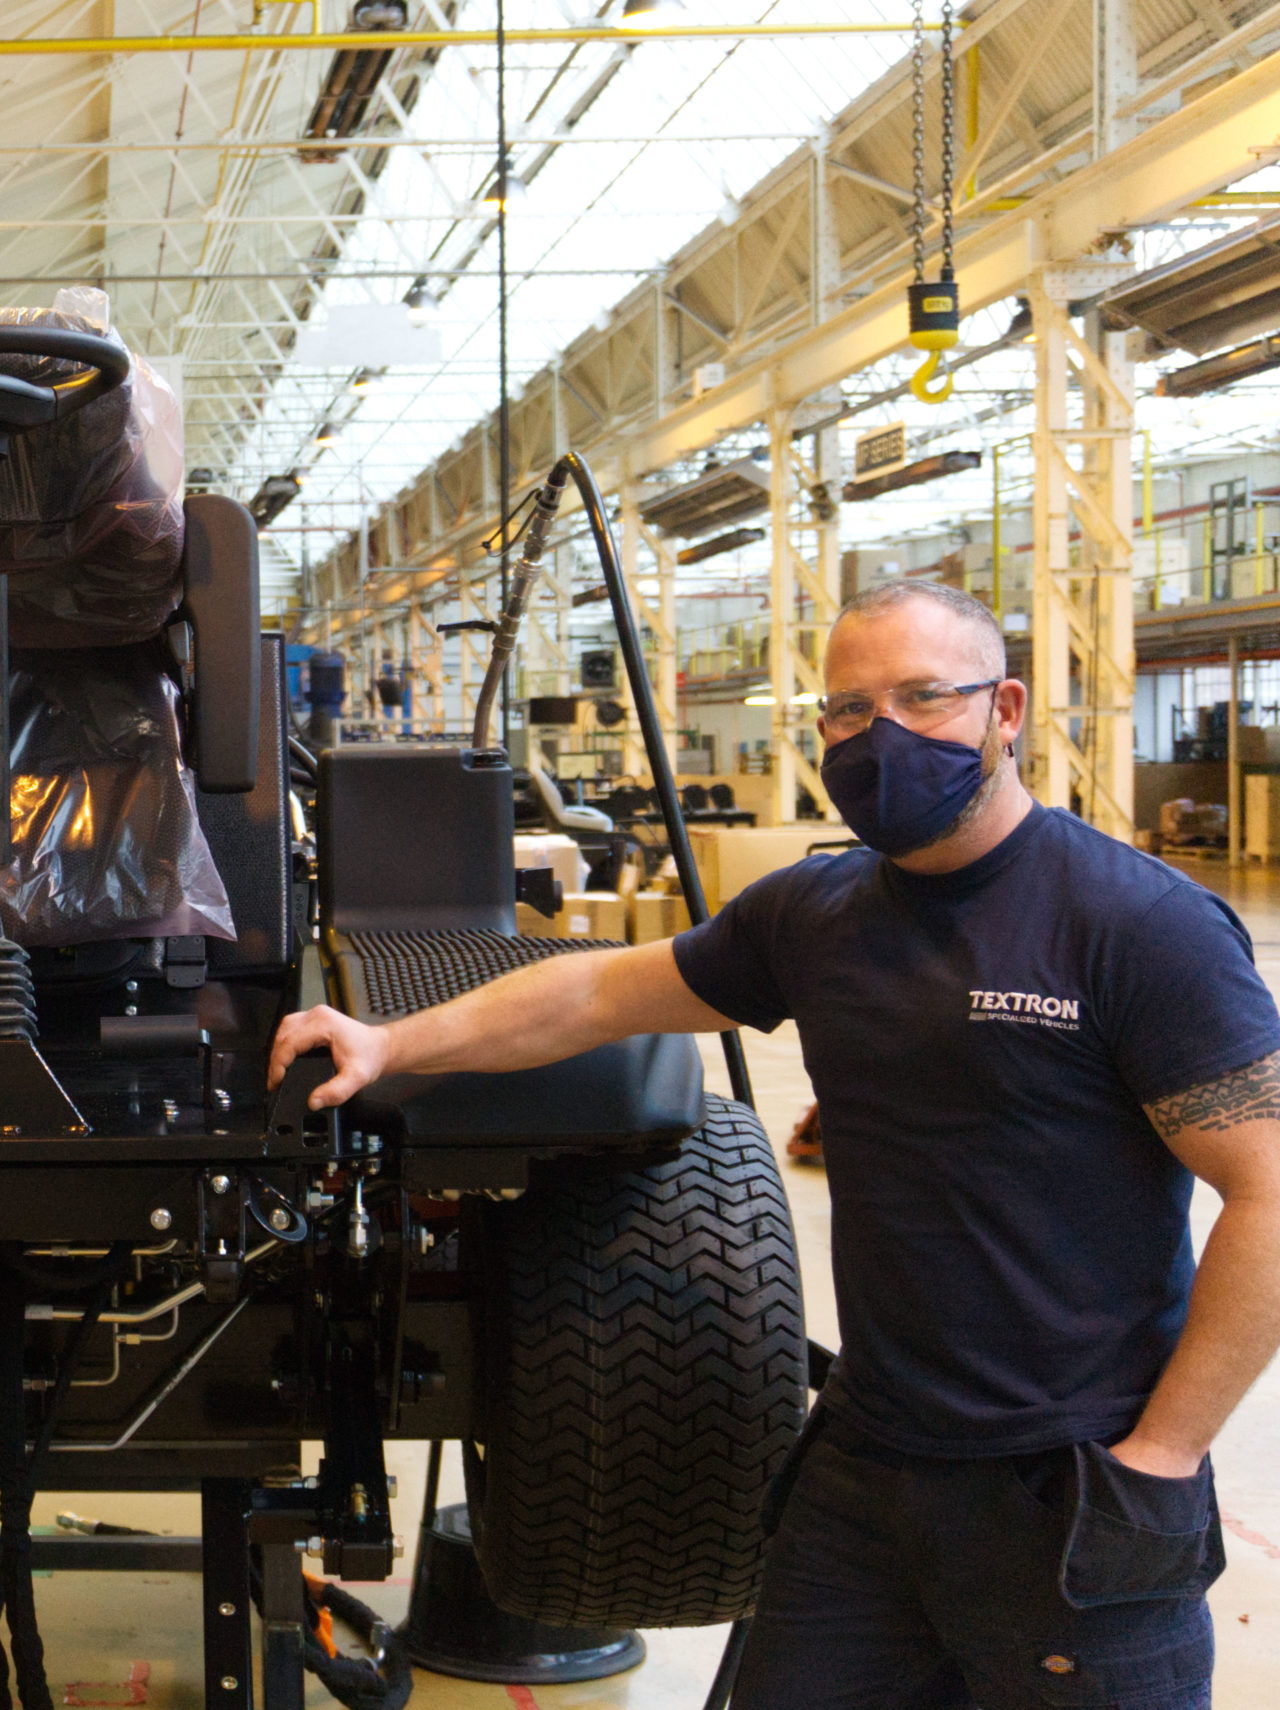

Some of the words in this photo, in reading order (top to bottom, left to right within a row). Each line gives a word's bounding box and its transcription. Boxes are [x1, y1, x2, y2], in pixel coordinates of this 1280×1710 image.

[969, 990, 1079, 1020] TEXTRON
[987, 1013, 1037, 1024] SPECIALIZED
[1039, 1018, 1079, 1030] VEHICLES
